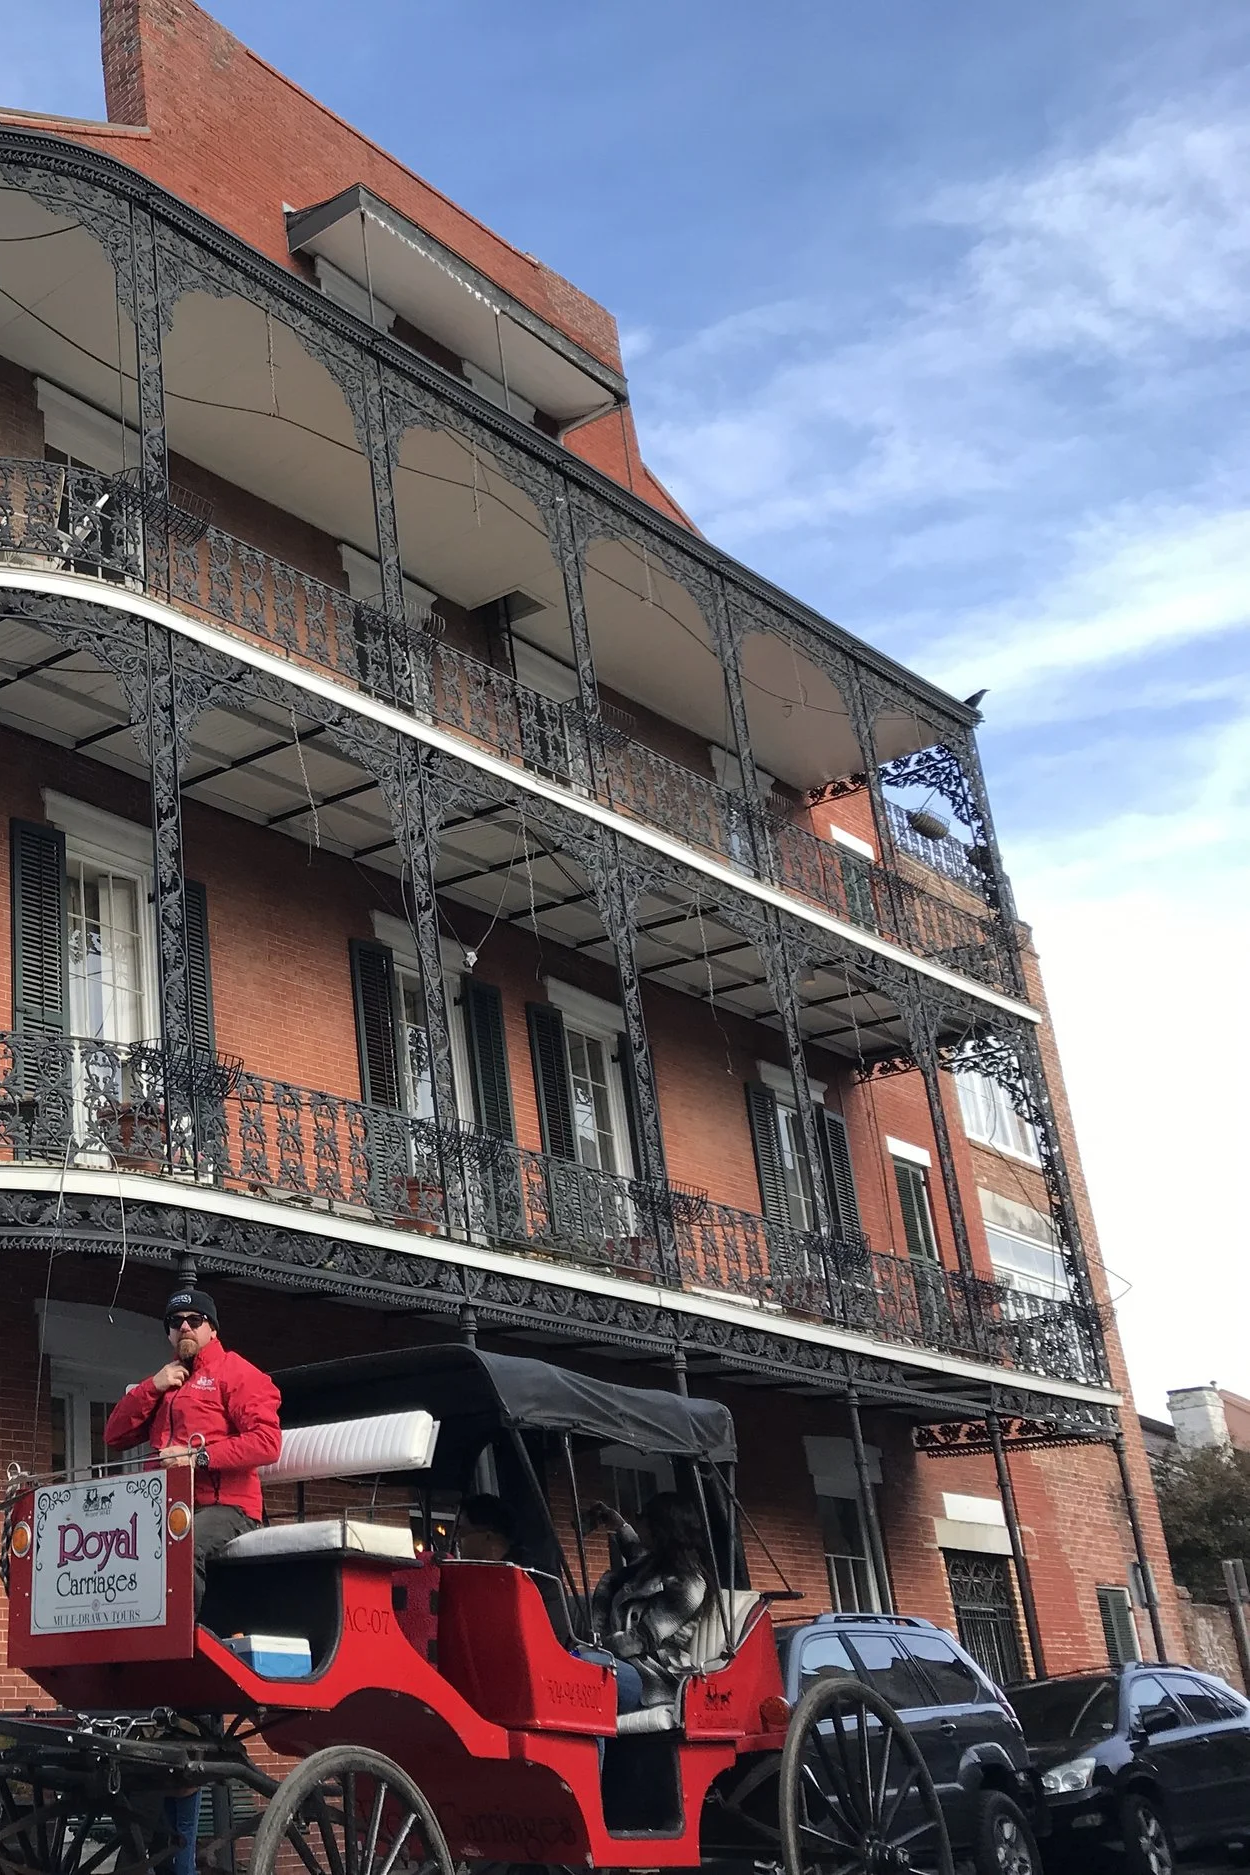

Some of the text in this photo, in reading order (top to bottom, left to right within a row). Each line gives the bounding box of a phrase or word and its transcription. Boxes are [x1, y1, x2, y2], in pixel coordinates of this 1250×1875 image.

[57, 1511, 139, 1572] Royal
[56, 1570, 138, 1603] Carriages
[53, 1609, 141, 1627] MULE-DRAWN TOURS
[344, 1605, 390, 1635] AC-07
